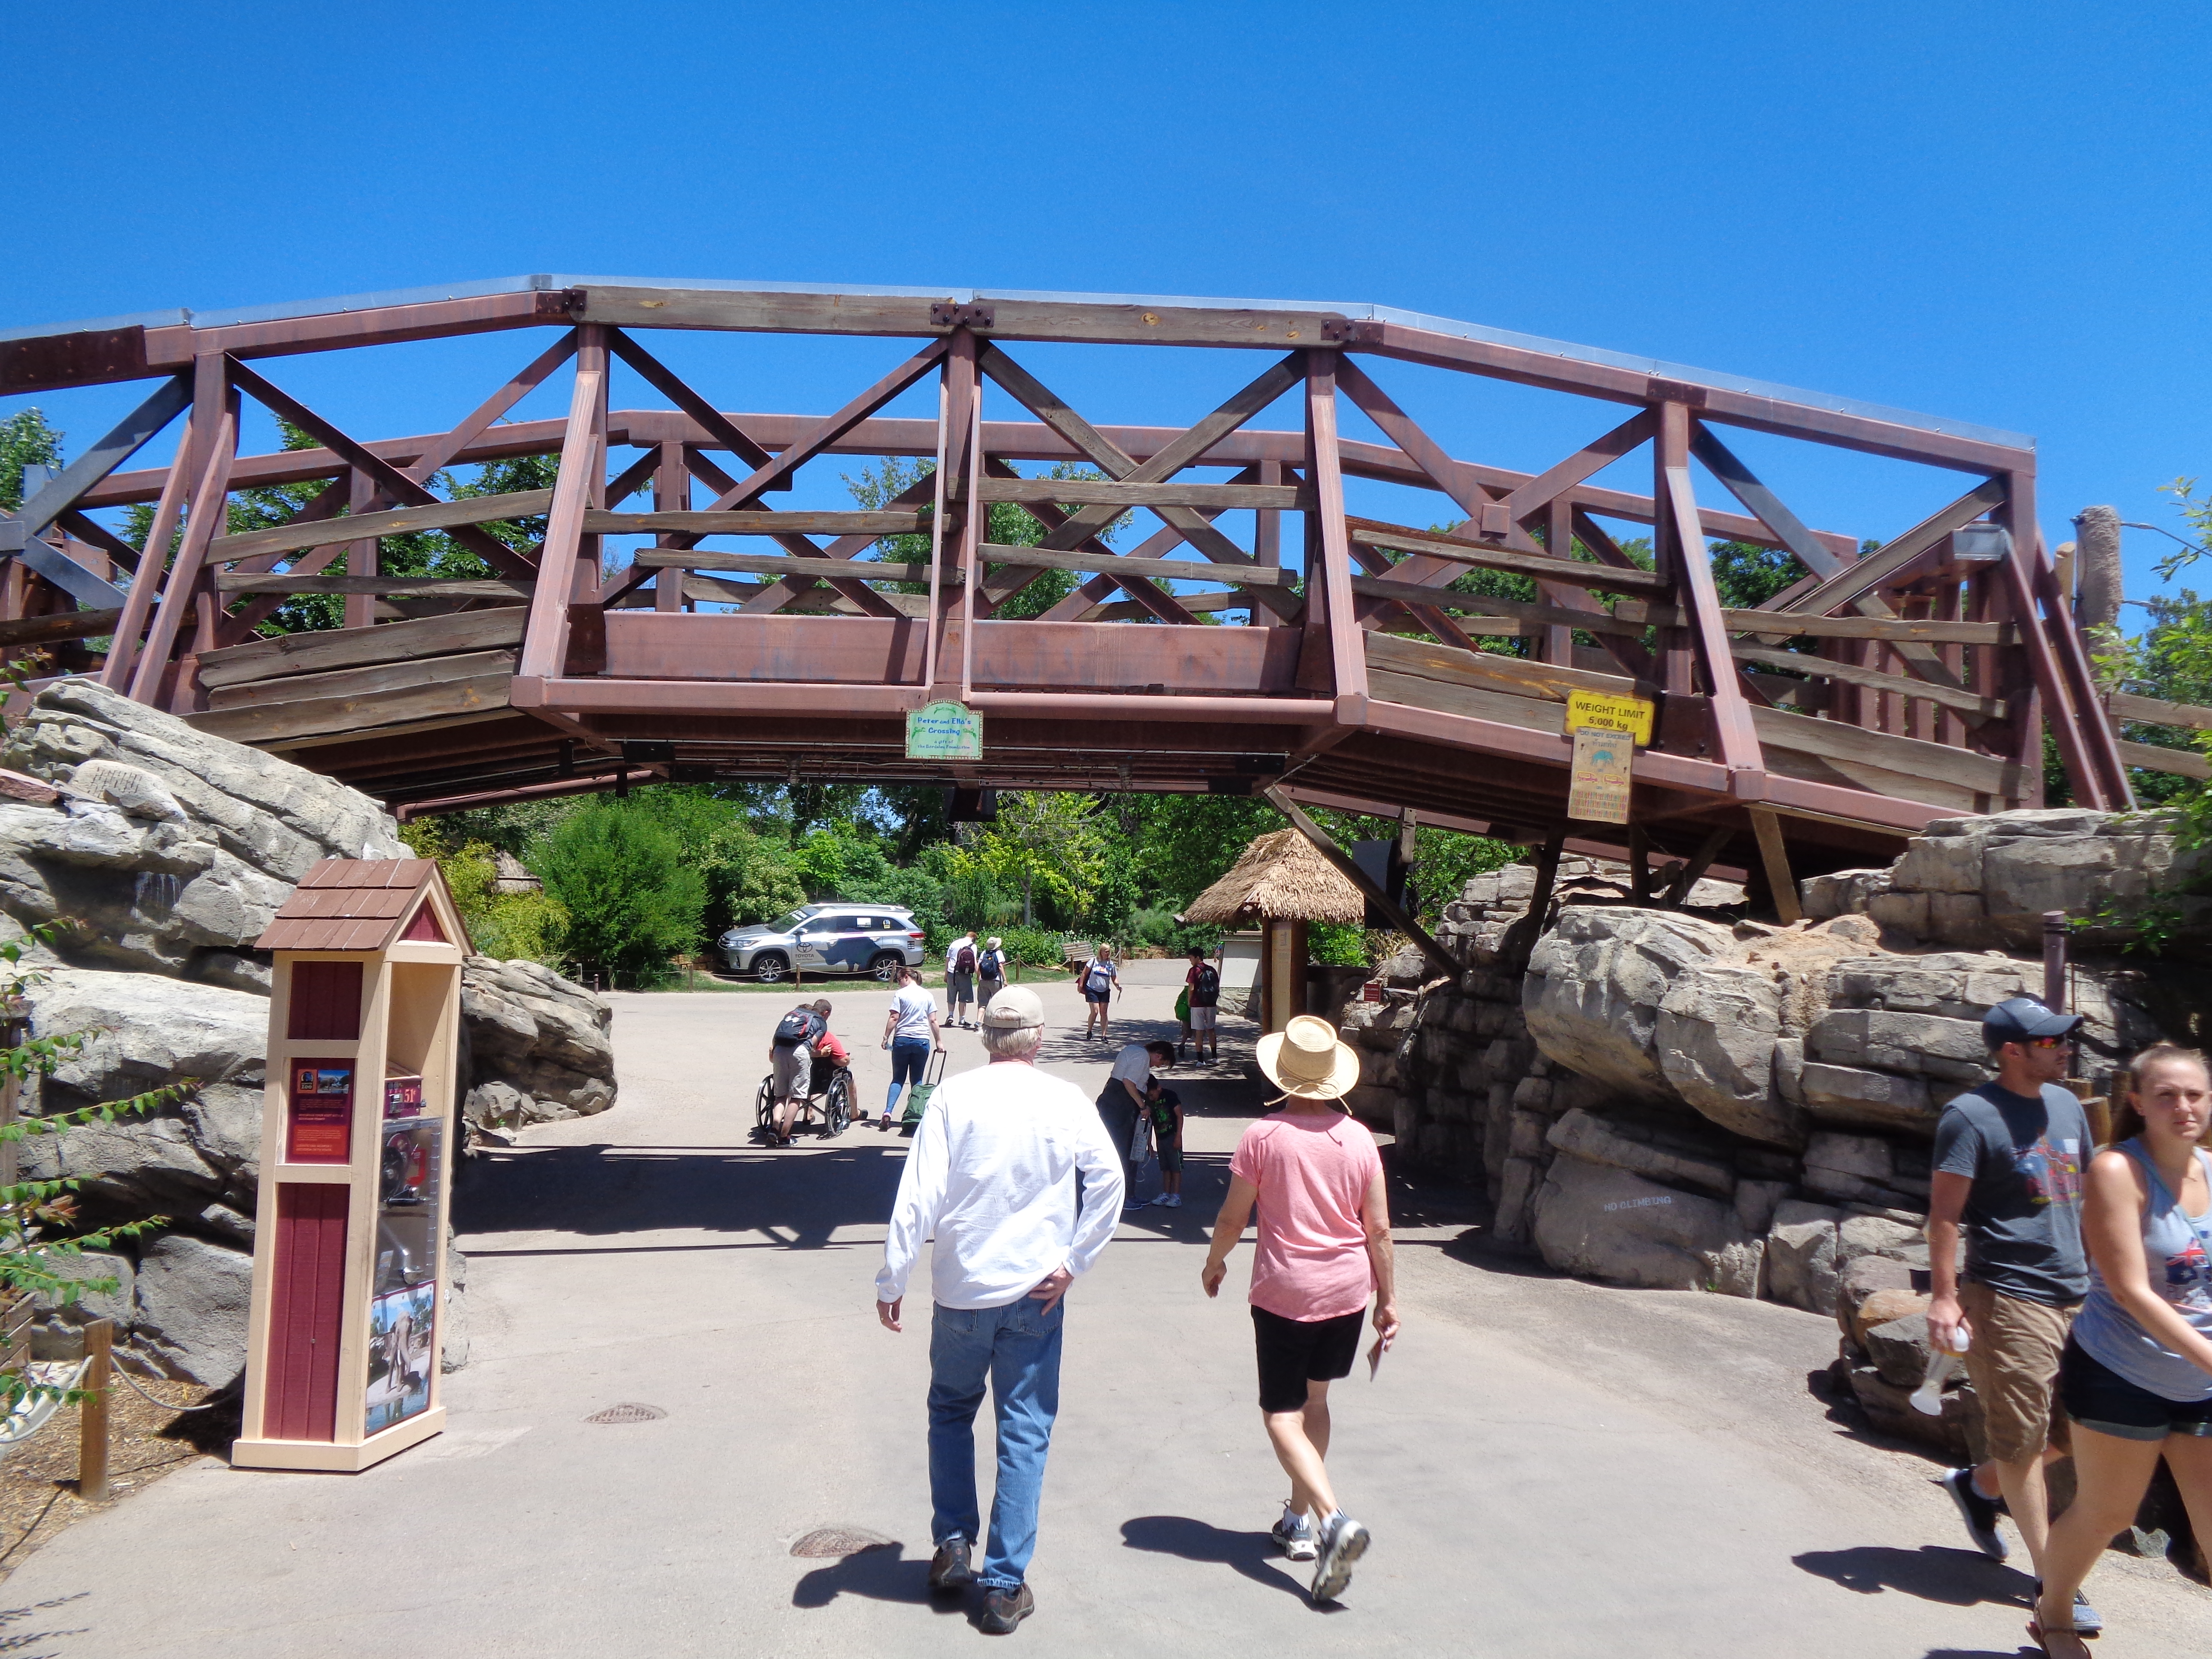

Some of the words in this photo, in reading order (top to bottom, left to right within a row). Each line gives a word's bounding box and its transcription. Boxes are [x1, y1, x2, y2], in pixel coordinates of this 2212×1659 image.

[1576, 701, 1616, 715] WEIGHT
[1619, 708, 1645, 719] LIMIT
[928, 727, 960, 735] Crossing
[1589, 716, 1614, 727] 5,000
[1617, 720, 1628, 731] kg
[1604, 1203, 1618, 1211] NO
[1620, 1196, 1672, 1209] CLIMBING
